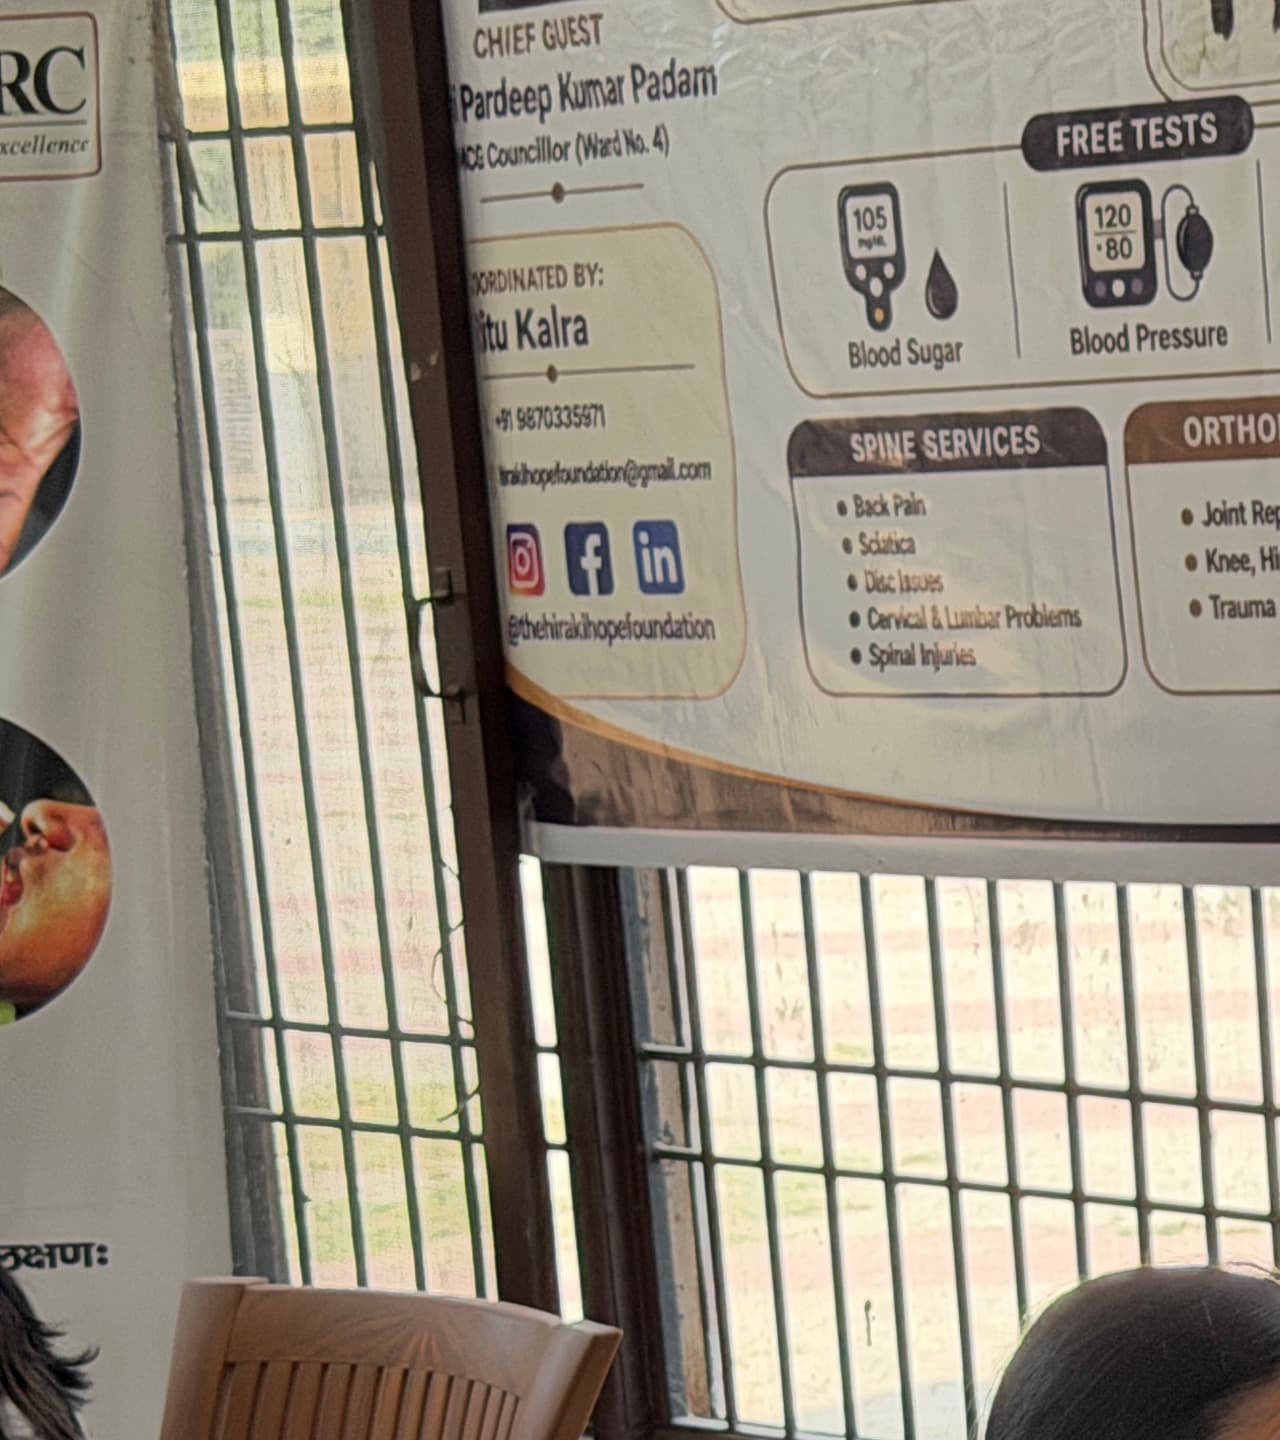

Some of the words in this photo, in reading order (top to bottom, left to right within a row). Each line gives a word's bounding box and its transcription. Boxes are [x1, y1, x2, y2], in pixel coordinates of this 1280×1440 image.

[473, 21, 535, 58] CHIEF
[542, 13, 603, 51] GUEST
[0, 45, 87, 115] RC
[460, 76, 551, 123] Pardeep
[558, 72, 624, 112] Kumar
[630, 56, 718, 103] Padam
[488, 135, 570, 168] Councillor
[576, 129, 622, 166] (Ward
[623, 128, 649, 153] No.
[653, 123, 669, 157] 4)
[1056, 121, 1123, 158] FREE
[1131, 111, 1218, 152] TESTS
[853, 206, 888, 232] 105
[1094, 203, 1131, 229] 120
[574, 262, 604, 288] BY:
[474, 308, 508, 353] itu
[515, 304, 589, 350] Kalra
[1070, 322, 1130, 355] Blood
[1136, 318, 1228, 352] Pressure
[848, 337, 902, 369] Blood
[907, 337, 963, 371] Sugar
[850, 431, 916, 464] SPINE
[922, 425, 1040, 457] SERVICES
[853, 493, 890, 518] Back
[893, 492, 927, 516] Pain
[1201, 499, 1247, 528] Joint
[859, 531, 916, 556] Sciatica
[1205, 547, 1256, 578] Knee,
[865, 569, 895, 594] Disc
[898, 568, 944, 592] Issues
[867, 605, 928, 631] Cervical
[931, 606, 942, 630] &
[945, 604, 1001, 630] Lumbar
[1004, 602, 1082, 629] Problems
[1208, 592, 1277, 620] Trauma
[869, 642, 916, 673] Spinal
[920, 642, 976, 672] Injuries
